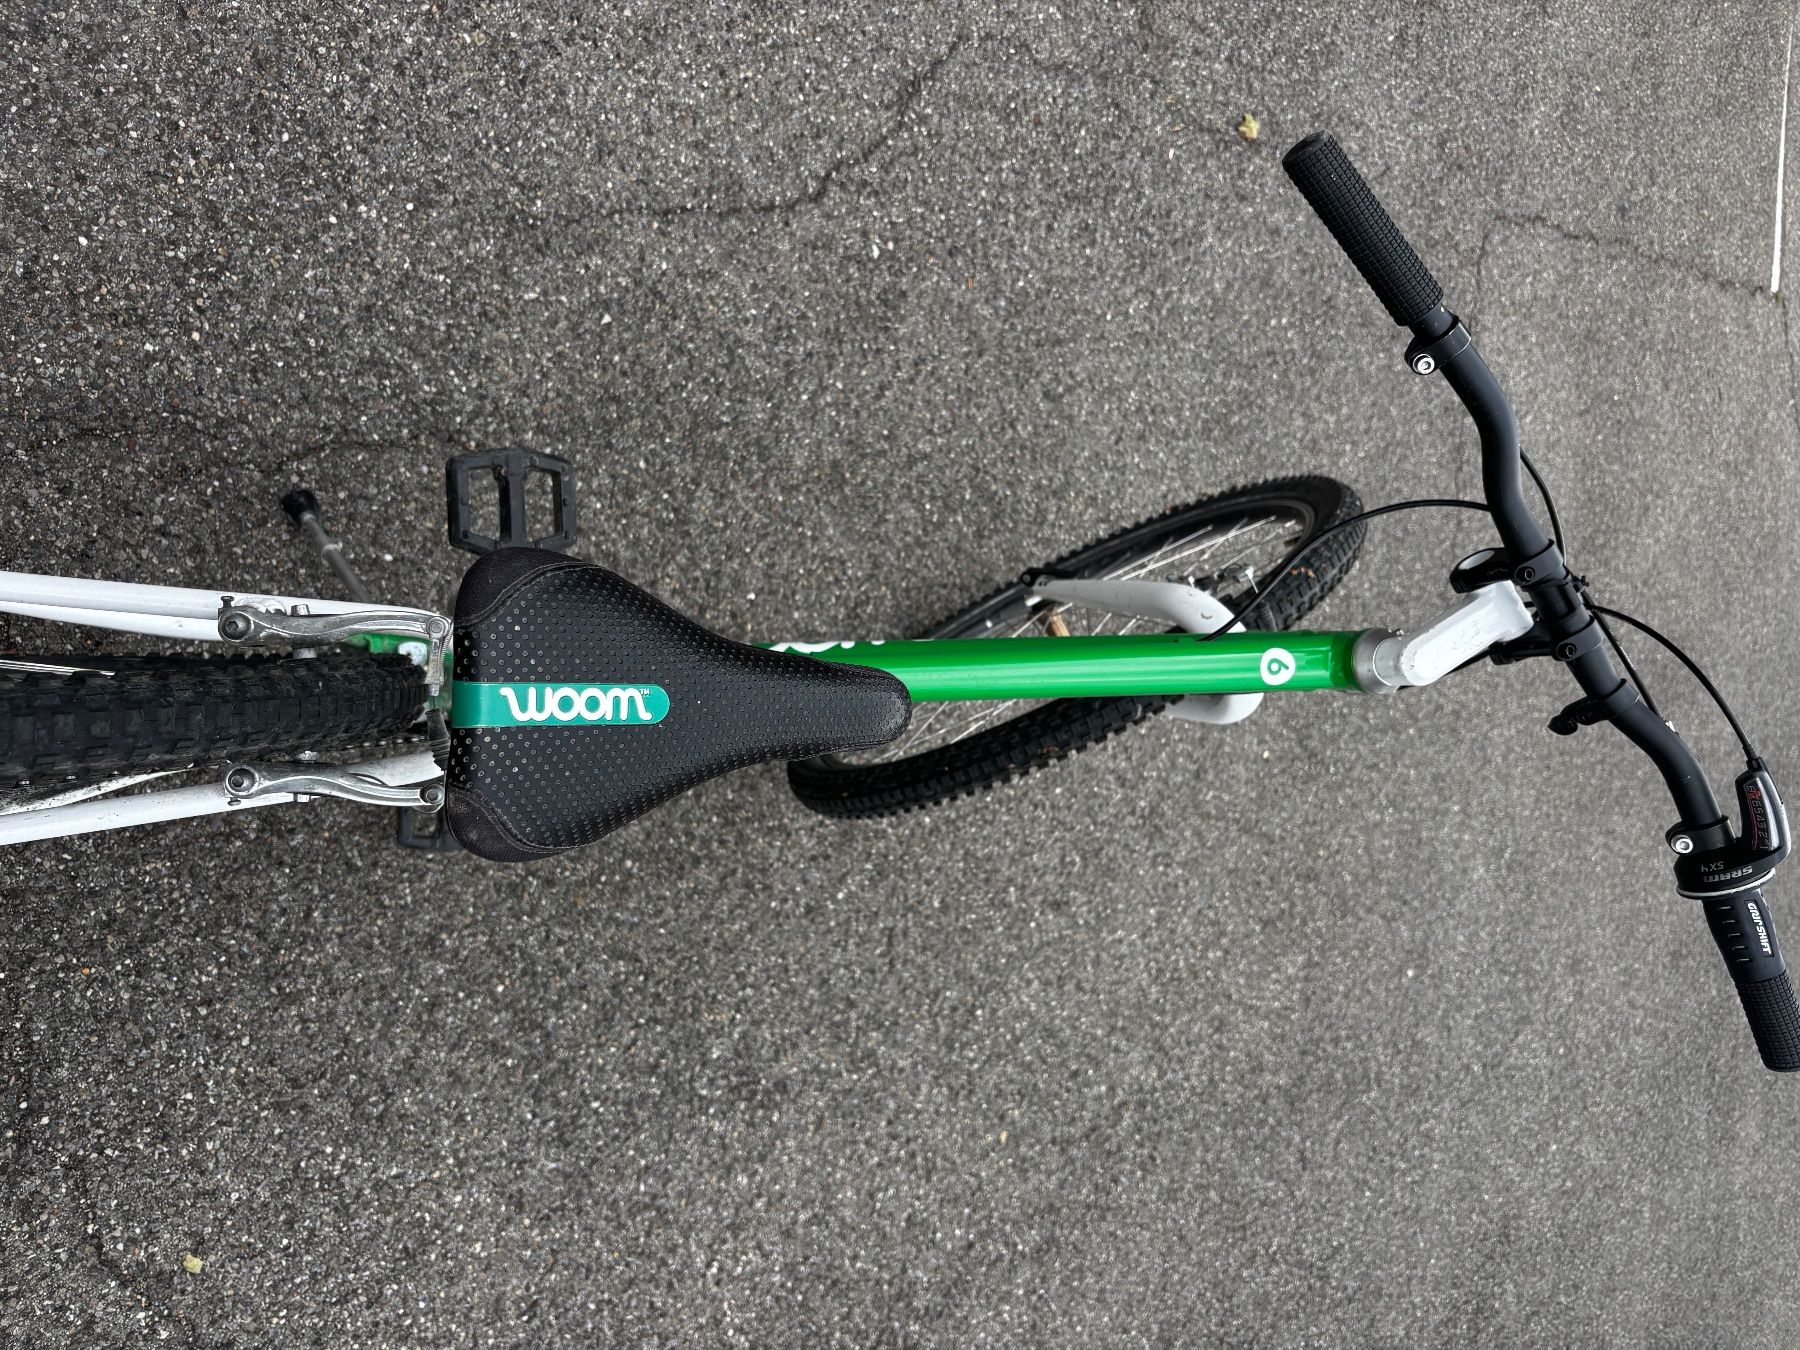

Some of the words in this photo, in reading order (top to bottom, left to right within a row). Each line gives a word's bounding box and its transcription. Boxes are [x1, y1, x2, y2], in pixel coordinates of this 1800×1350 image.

[1267, 658, 1289, 676] 6
[500, 687, 652, 721] woom
[1703, 866, 1753, 882] SRAM
